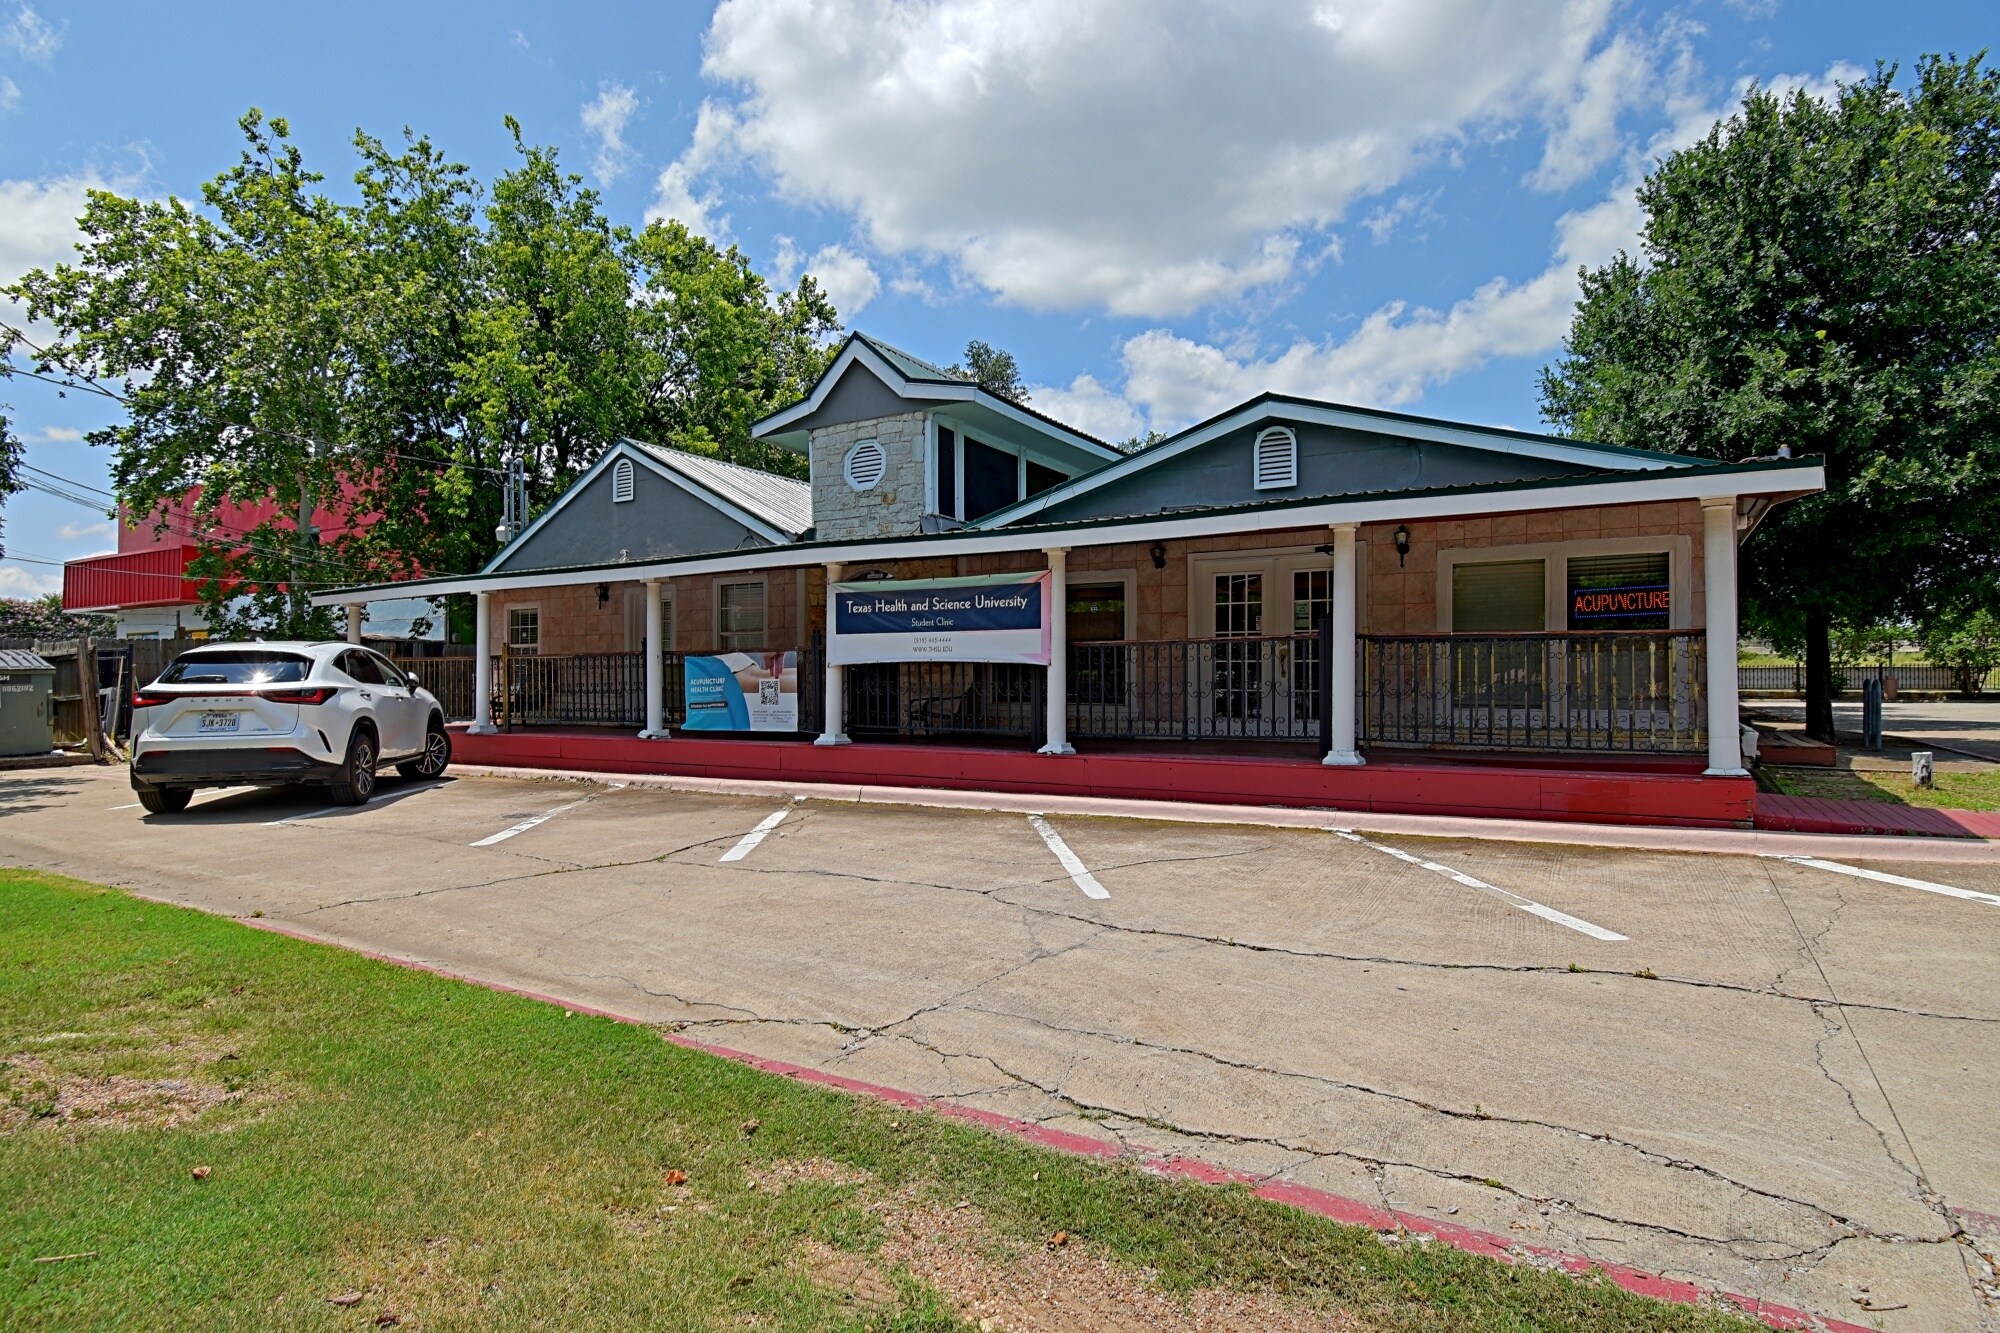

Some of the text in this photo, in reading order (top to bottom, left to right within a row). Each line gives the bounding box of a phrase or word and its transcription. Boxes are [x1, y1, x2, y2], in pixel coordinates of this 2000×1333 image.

[846, 594, 1028, 614] Texas Health and Science University
[1574, 591, 1670, 612] ACUPUNCTURE
[911, 616, 954, 627] Student Clinic
[690, 677, 726, 686] ACUPUNCTURE
